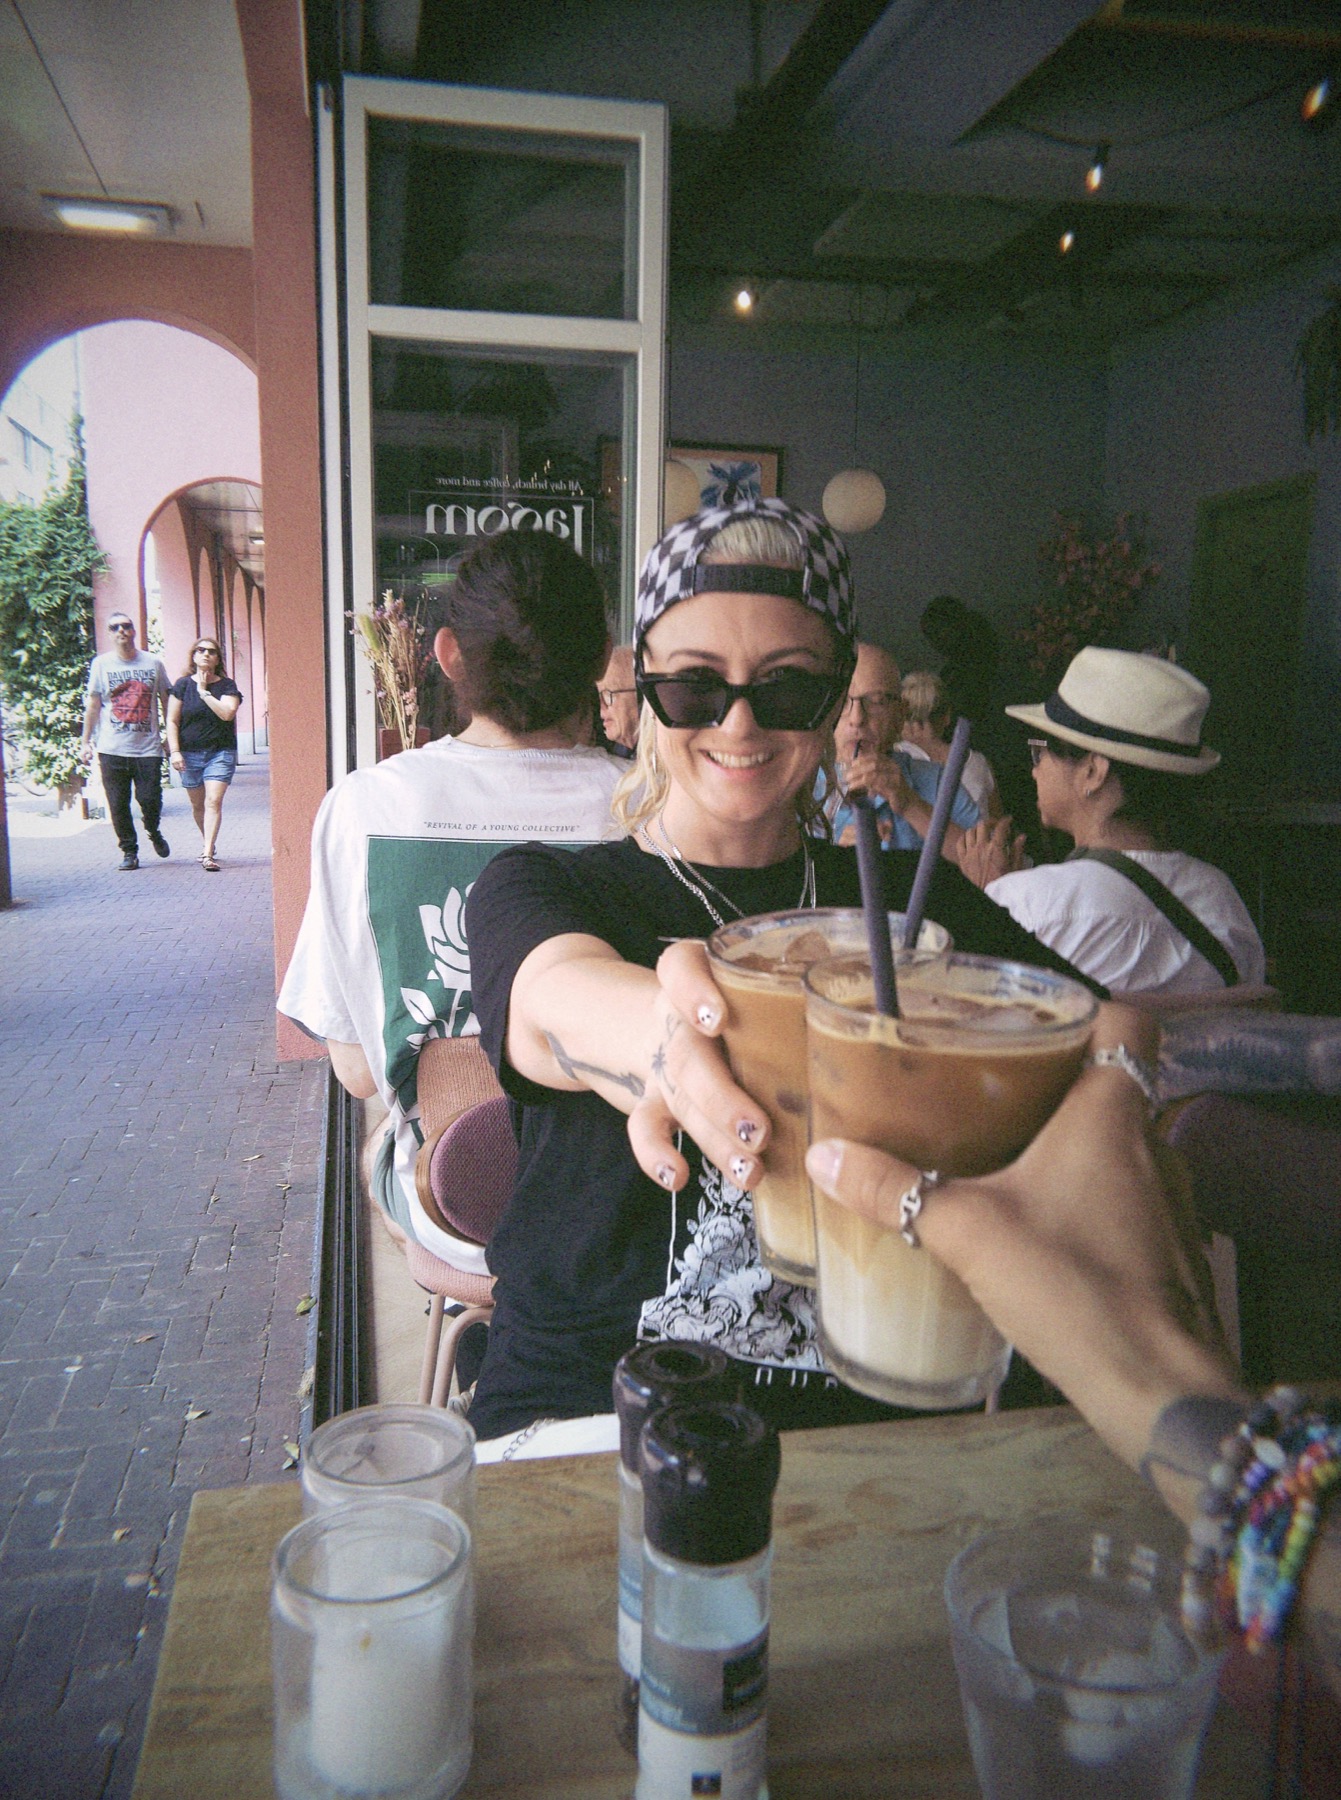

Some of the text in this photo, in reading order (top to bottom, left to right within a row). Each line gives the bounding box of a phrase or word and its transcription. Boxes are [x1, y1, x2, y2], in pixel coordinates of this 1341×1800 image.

[107, 669, 156, 680] DAVID BOWIE
[465, 823, 478, 831] OF
[490, 824, 520, 832] YOUNG
